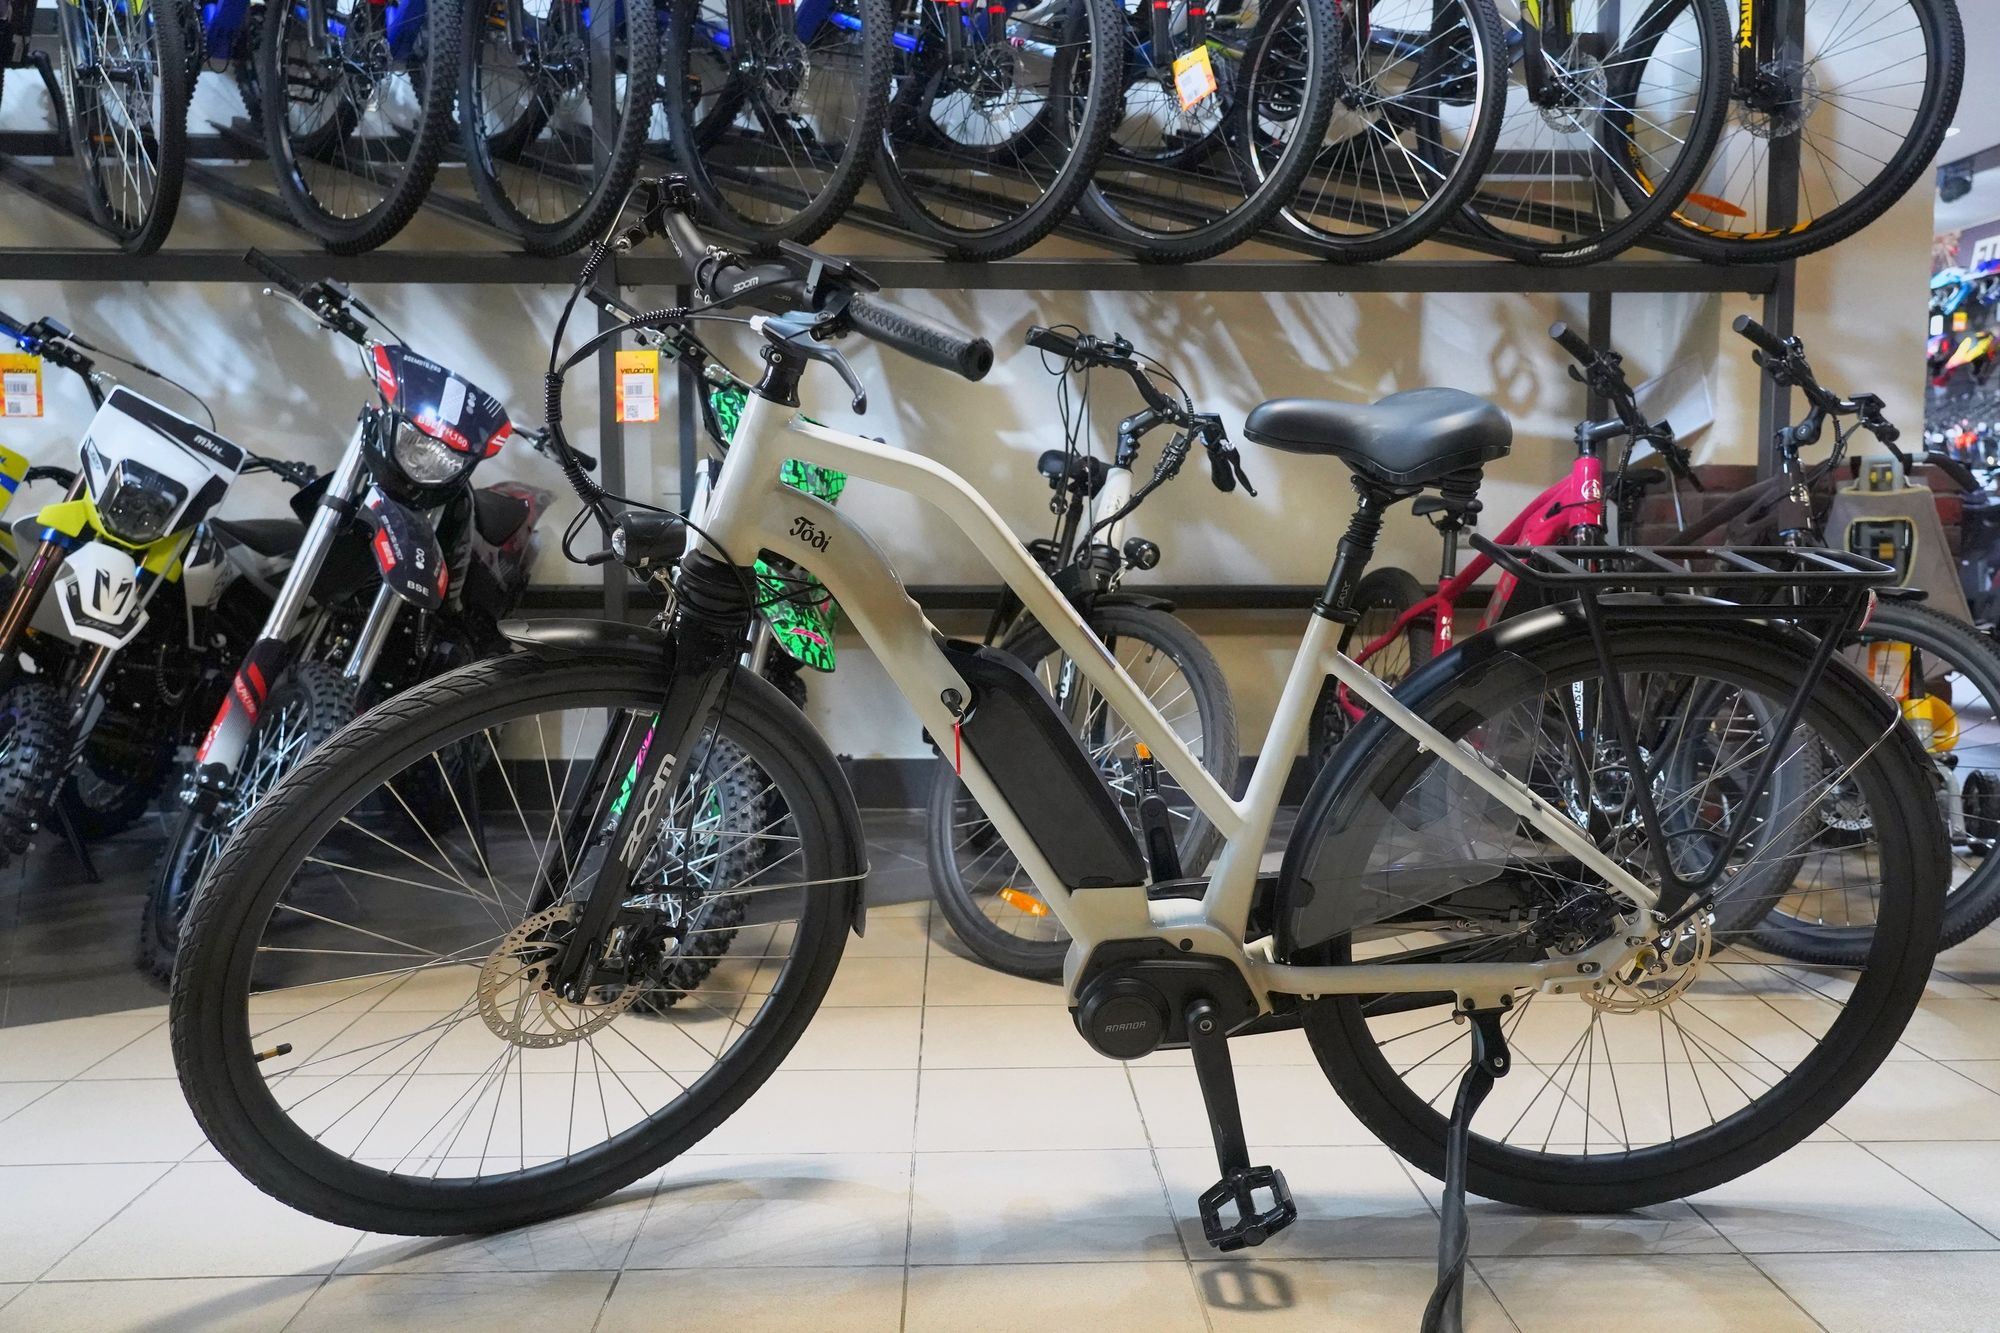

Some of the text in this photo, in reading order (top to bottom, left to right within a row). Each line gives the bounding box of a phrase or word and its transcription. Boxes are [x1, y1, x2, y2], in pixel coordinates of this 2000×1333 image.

[732, 276, 759, 293] ZOOM
[407, 580, 430, 597] BSE
[619, 753, 677, 868] ZOOM
